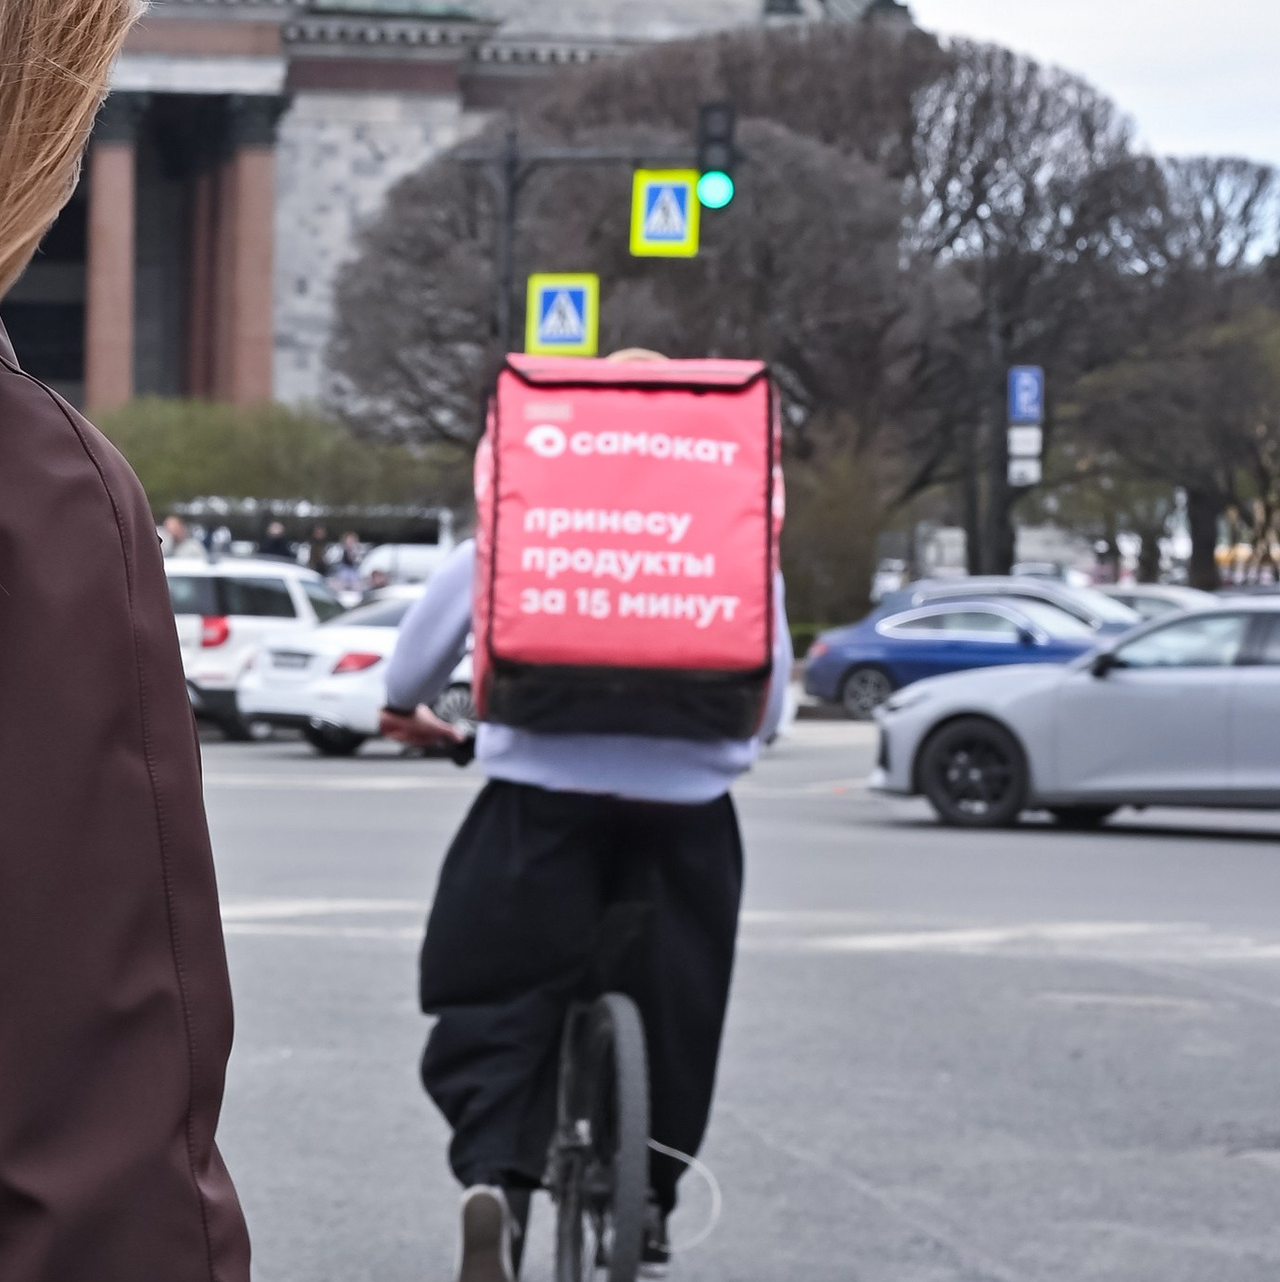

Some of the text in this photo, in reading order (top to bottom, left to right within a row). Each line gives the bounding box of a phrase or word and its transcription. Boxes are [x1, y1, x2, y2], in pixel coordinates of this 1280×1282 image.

[569, 430, 738, 465] самокат
[524, 507, 692, 543] принесу
[521, 547, 714, 583] продукты
[521, 588, 738, 628] за 15 минут
